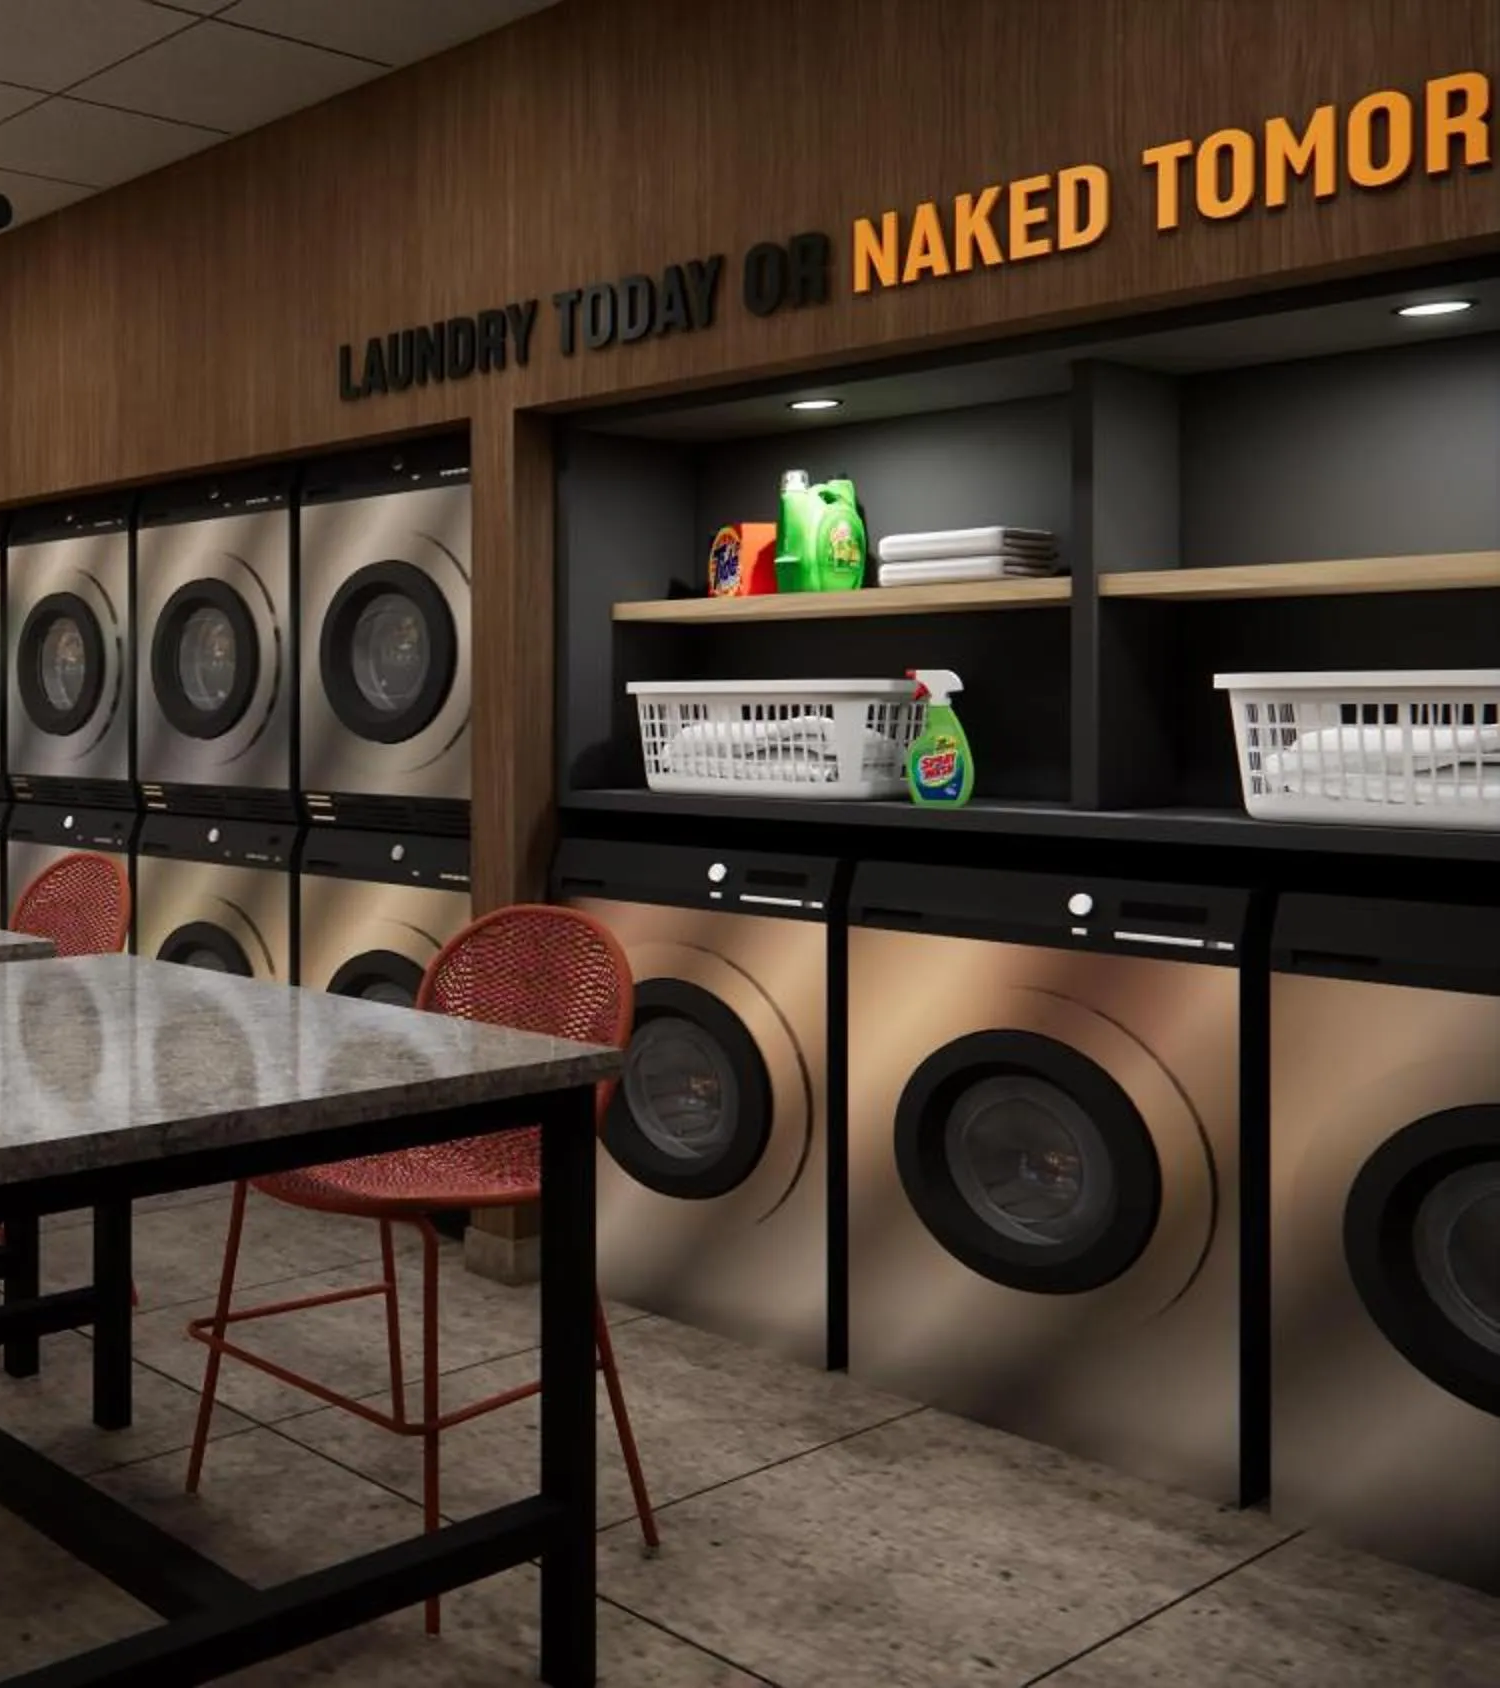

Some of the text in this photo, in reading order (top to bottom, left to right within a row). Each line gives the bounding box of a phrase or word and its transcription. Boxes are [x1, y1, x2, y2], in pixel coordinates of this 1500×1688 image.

[339, 71, 1491, 401] LAUNDRY TODAY OR NAKED TOMOR
